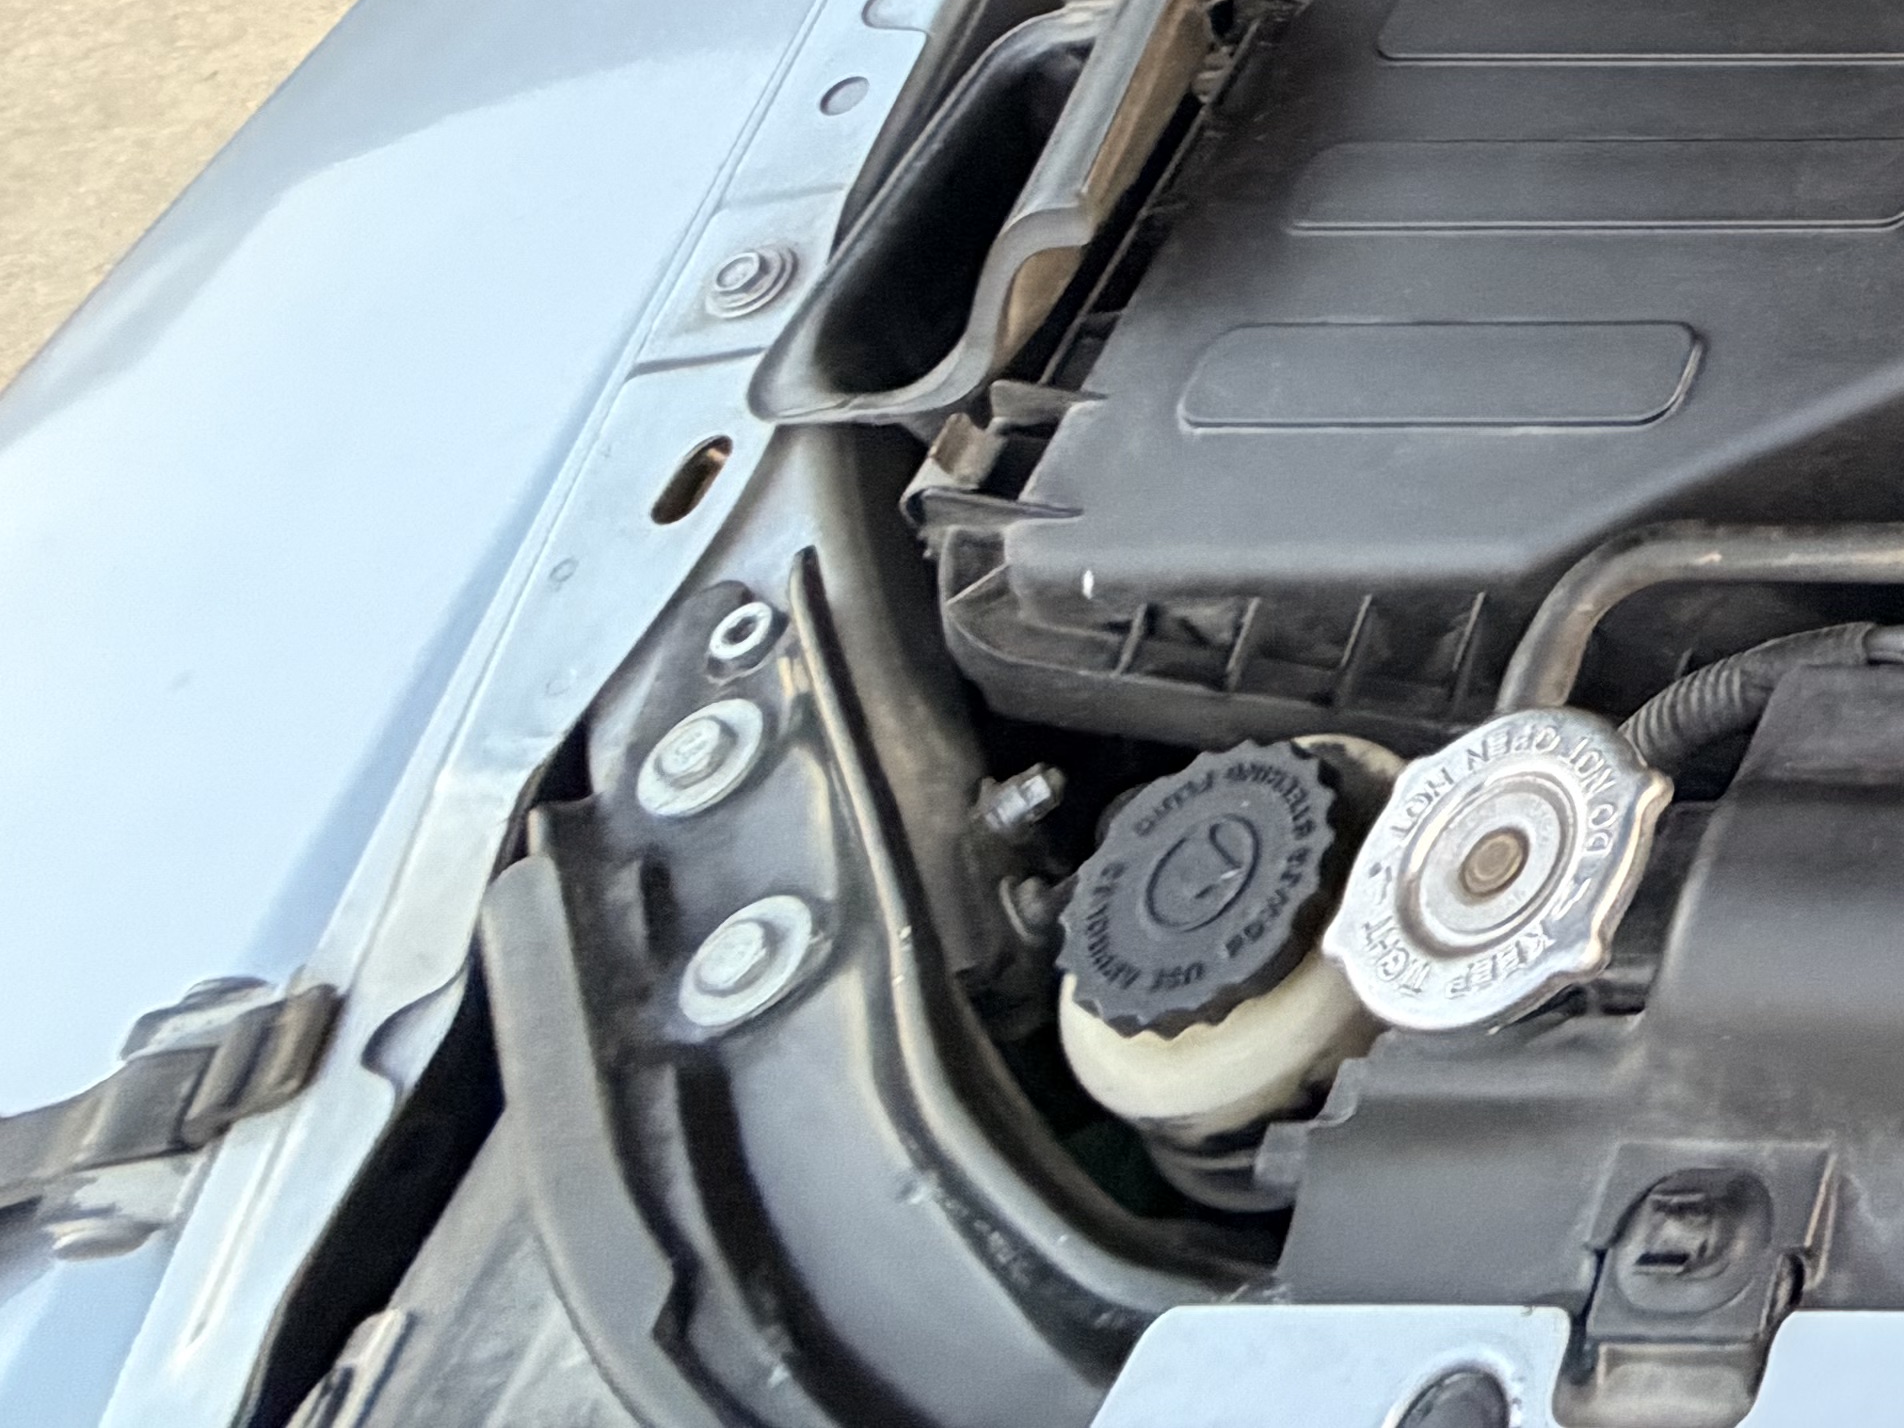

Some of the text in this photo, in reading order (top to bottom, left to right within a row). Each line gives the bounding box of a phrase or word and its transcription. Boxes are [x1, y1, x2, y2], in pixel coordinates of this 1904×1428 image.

[1392, 725, 1620, 857] DO NOT OPEN HOT
[1444, 920, 1557, 1001] KEEP
